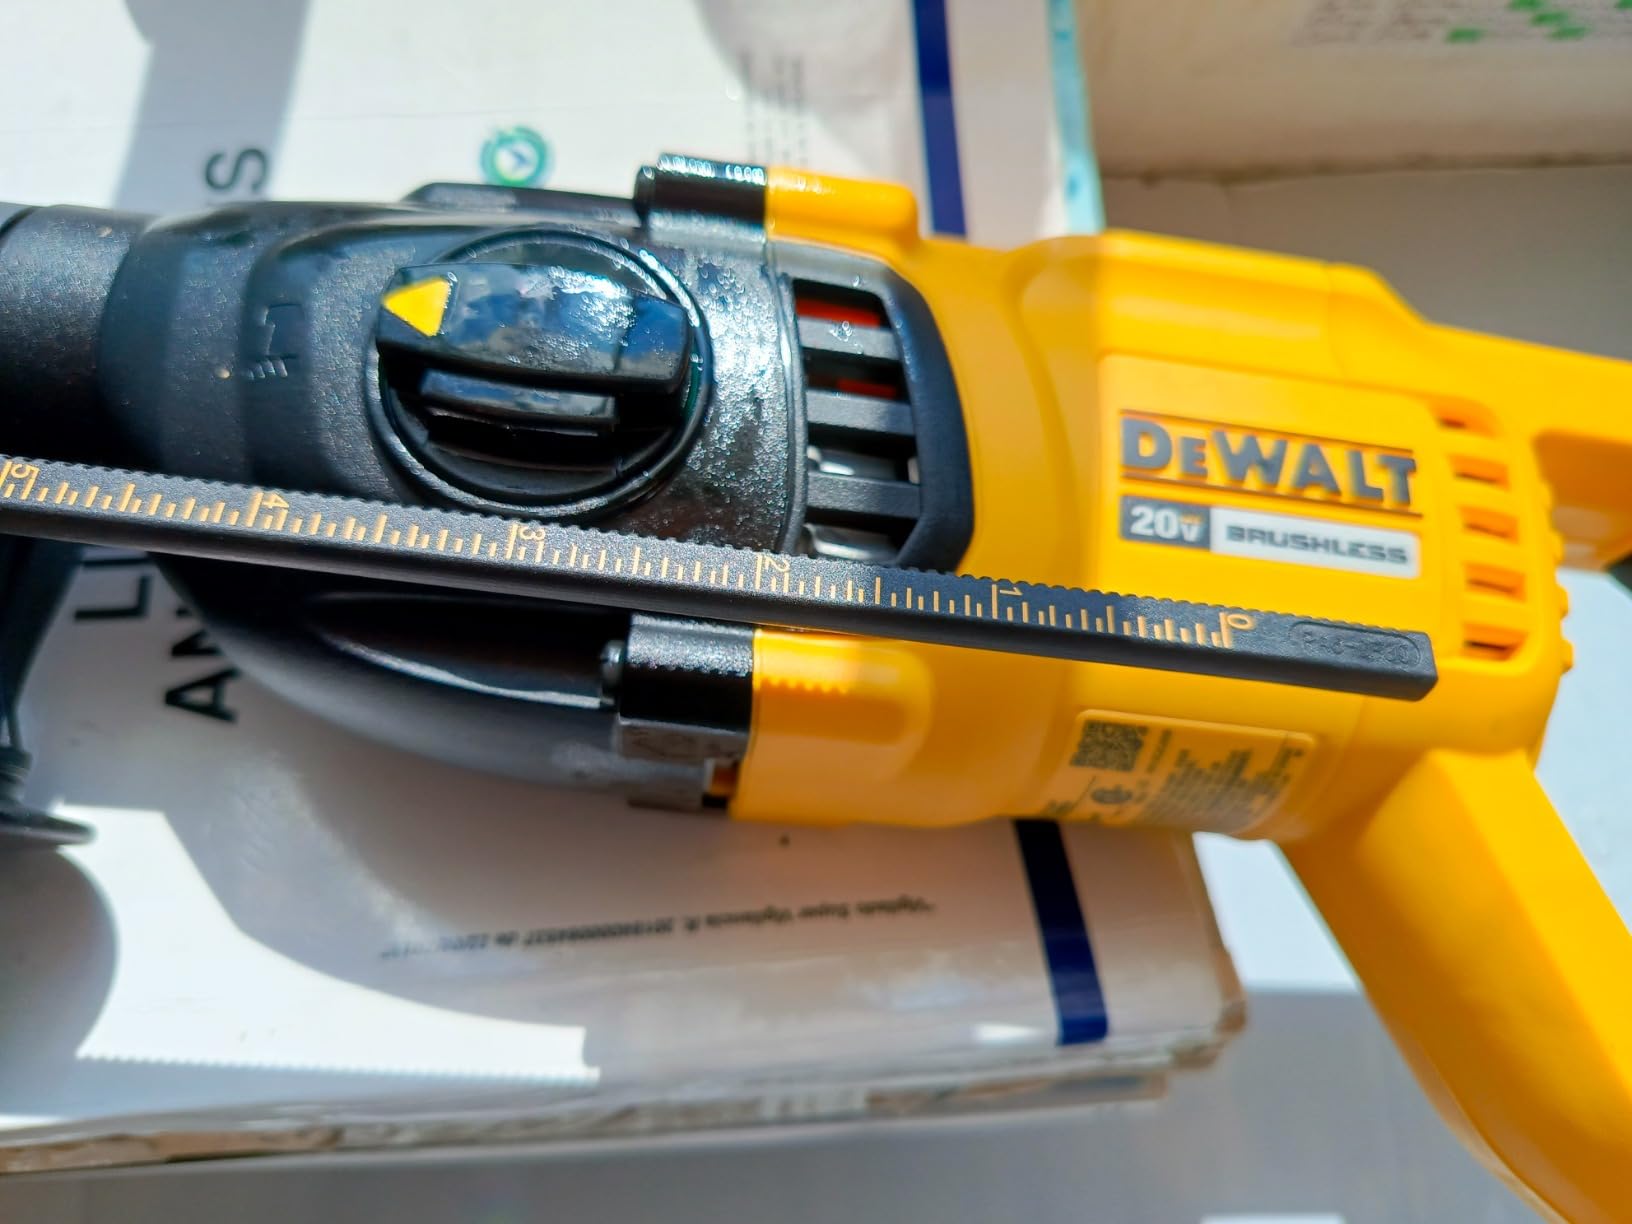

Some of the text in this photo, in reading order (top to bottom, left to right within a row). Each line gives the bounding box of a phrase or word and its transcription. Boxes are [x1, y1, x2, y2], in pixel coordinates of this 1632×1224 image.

[1121, 418, 1417, 506] DEWALT
[11, 463, 40, 479] 5
[262, 491, 290, 508] 4
[520, 525, 546, 541] 3
[1226, 524, 1408, 564] BRUSHLESS
[764, 556, 790, 572] 2
